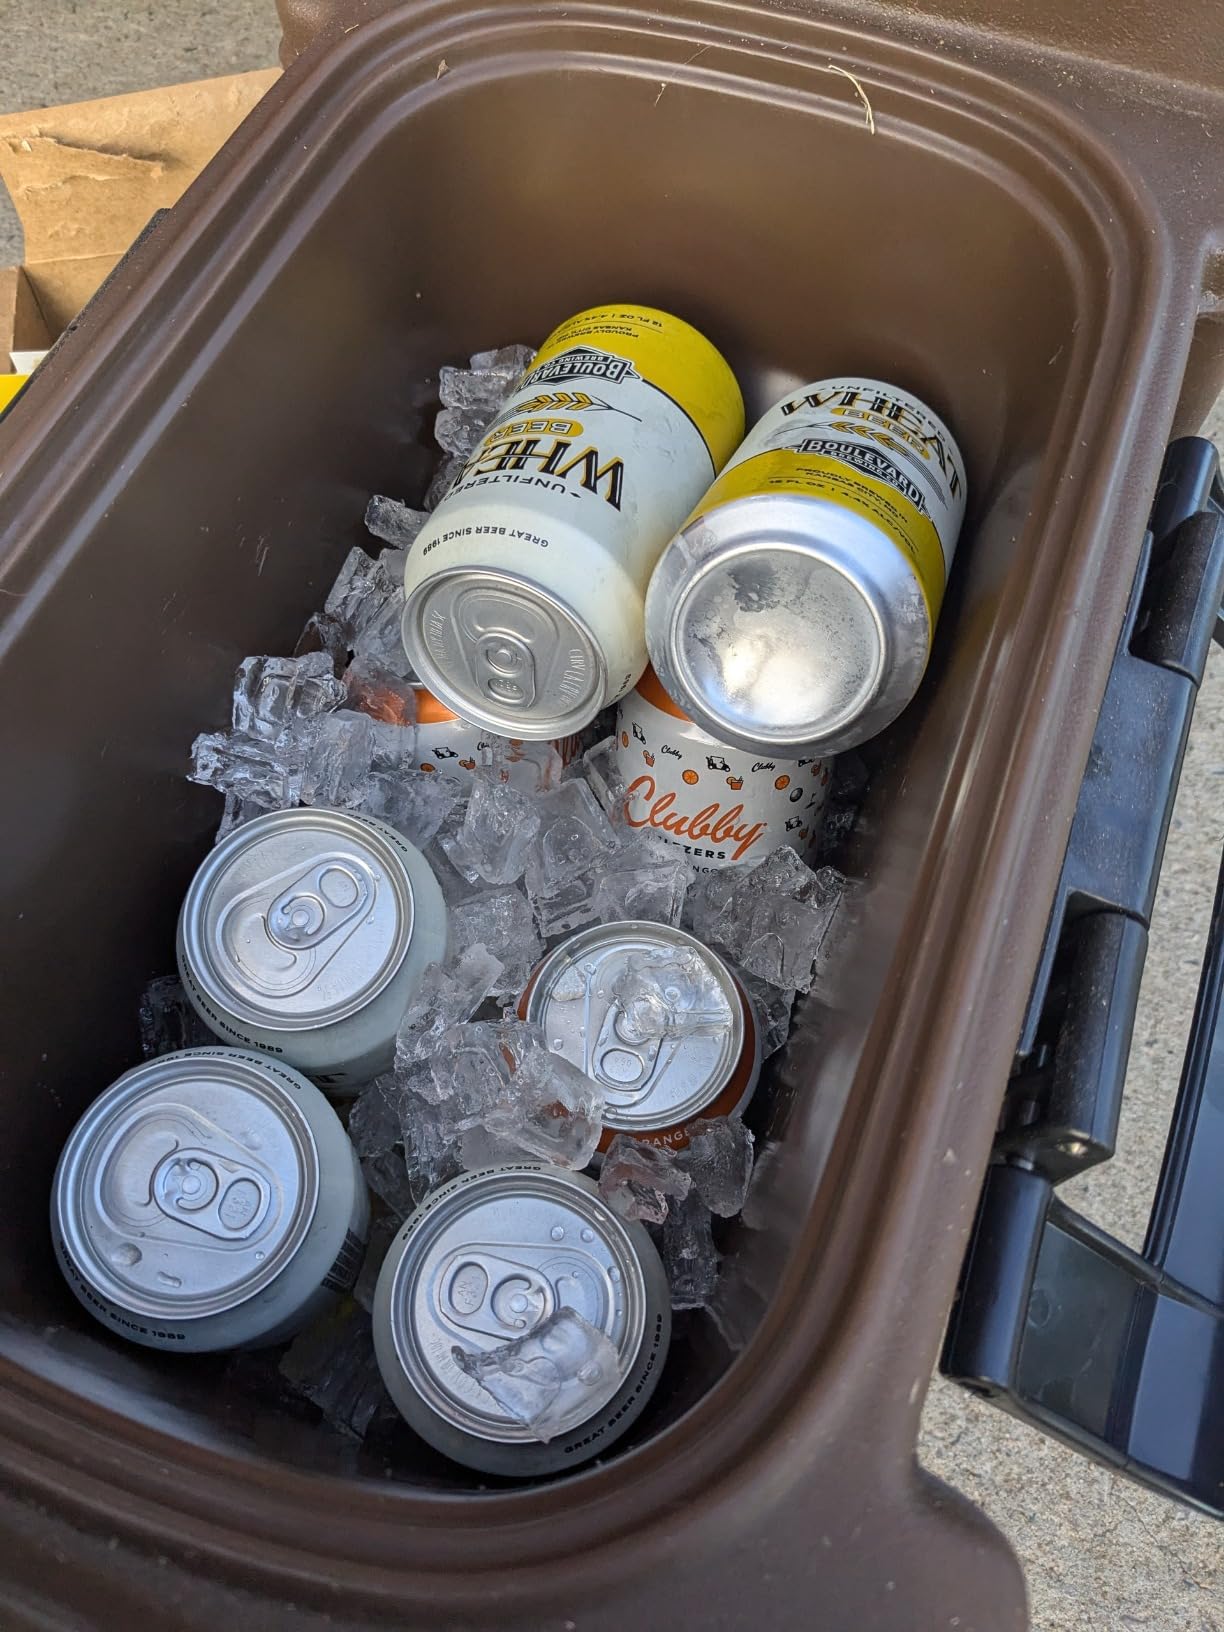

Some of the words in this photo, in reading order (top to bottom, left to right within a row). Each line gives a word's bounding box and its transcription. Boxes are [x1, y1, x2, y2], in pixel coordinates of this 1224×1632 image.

[593, 329, 639, 339] PROUDLY
[560, 354, 604, 362] BREWING
[490, 420, 574, 442] BEER
[843, 409, 926, 454] BEER
[780, 390, 962, 500] WHEAT
[452, 438, 624, 512] WHEA
[808, 440, 920, 504] BOULEVARD
[829, 450, 883, 475] BREWING
[796, 467, 852, 482] PROUDLY
[853, 480, 898, 514] BREWED
[805, 472, 855, 488] KANSAS
[442, 526, 472, 543] SINCE
[475, 525, 507, 535] BEER
[508, 528, 549, 548] GREAT
[422, 539, 441, 556] 1989
[661, 744, 683, 760] Clubby
[751, 762, 776, 773] Clubby
[623, 775, 768, 861] Clubby
[377, 826, 408, 852] GREAT
[196, 994, 218, 1021] BEER
[219, 1021, 251, 1044] SINCE
[253, 1041, 283, 1053] 1989
[228, 1053, 263, 1065] BEER
[264, 1065, 302, 1090] GREAT
[461, 1169, 495, 1184] BEER
[425, 1184, 458, 1210] SINCE
[402, 1213, 423, 1240] 1989
[80, 1284, 107, 1313] BEER
[110, 1312, 148, 1334] SINCE
[152, 1330, 186, 1341] 1989
[563, 1426, 605, 1454] GREAT
[608, 1396, 635, 1427] BEER
[635, 1352, 656, 1394] SINCE
[653, 1313, 663, 1348] 1989
